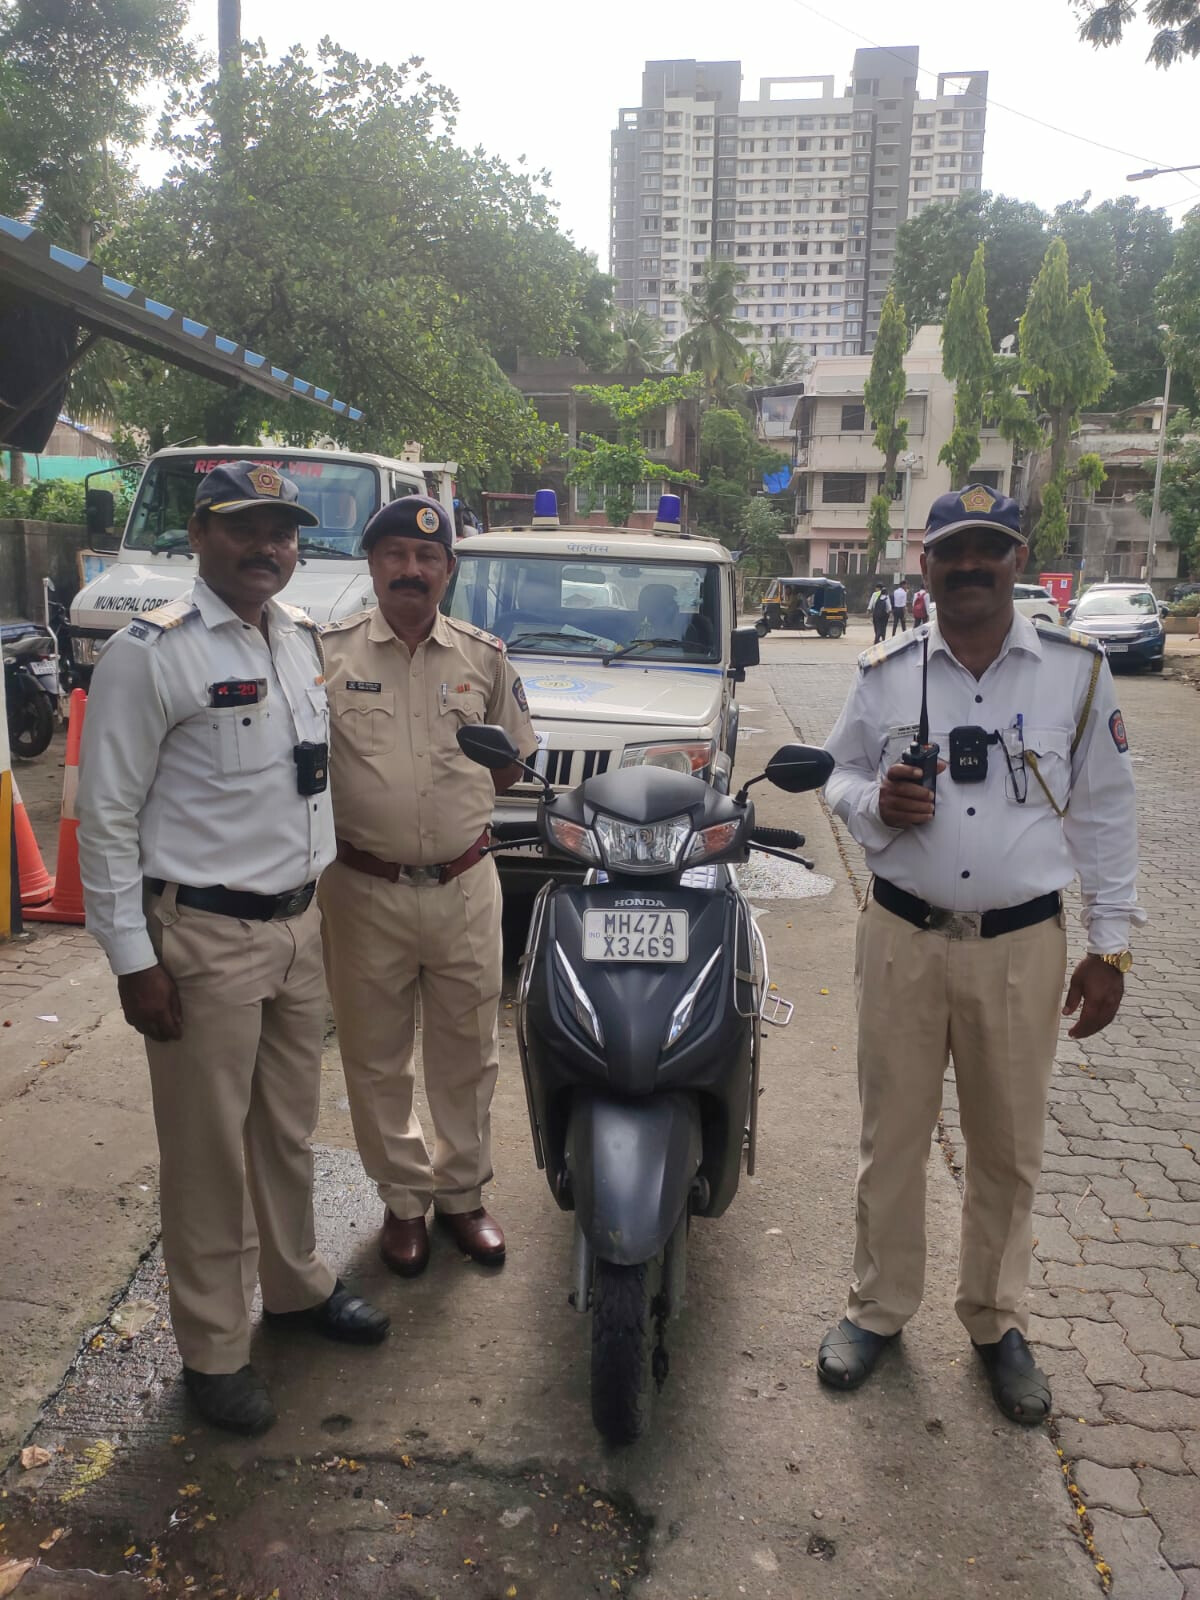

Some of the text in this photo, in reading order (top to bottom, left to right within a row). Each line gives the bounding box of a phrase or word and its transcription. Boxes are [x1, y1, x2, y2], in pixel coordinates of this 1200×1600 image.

[94, 596, 141, 612] MUNICIPAL
[614, 898, 666, 908] HONDA
[604, 913, 675, 936] MH47A
[603, 936, 675, 958] X3469
